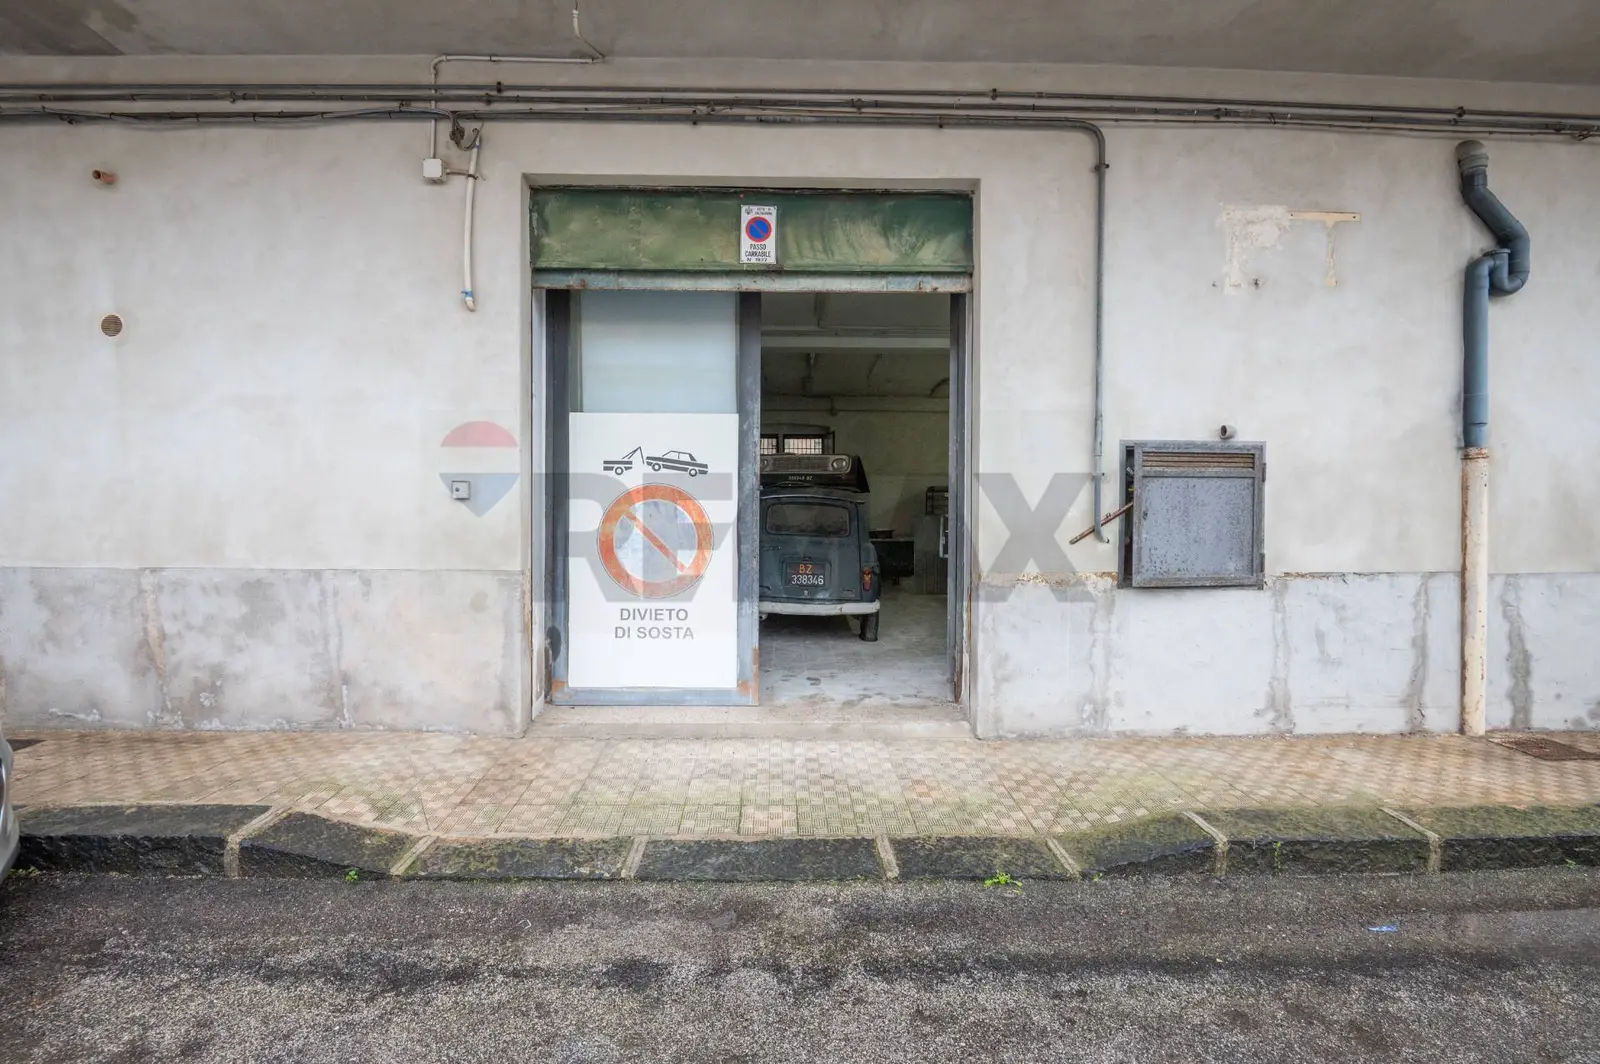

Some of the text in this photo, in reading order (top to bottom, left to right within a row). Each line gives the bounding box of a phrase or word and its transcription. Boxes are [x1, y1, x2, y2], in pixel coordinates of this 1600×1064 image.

[799, 564, 812, 574] BZ
[791, 574, 824, 585] 338346
[620, 608, 688, 621] DIVIETO
[615, 626, 694, 639] DI SOSTA
